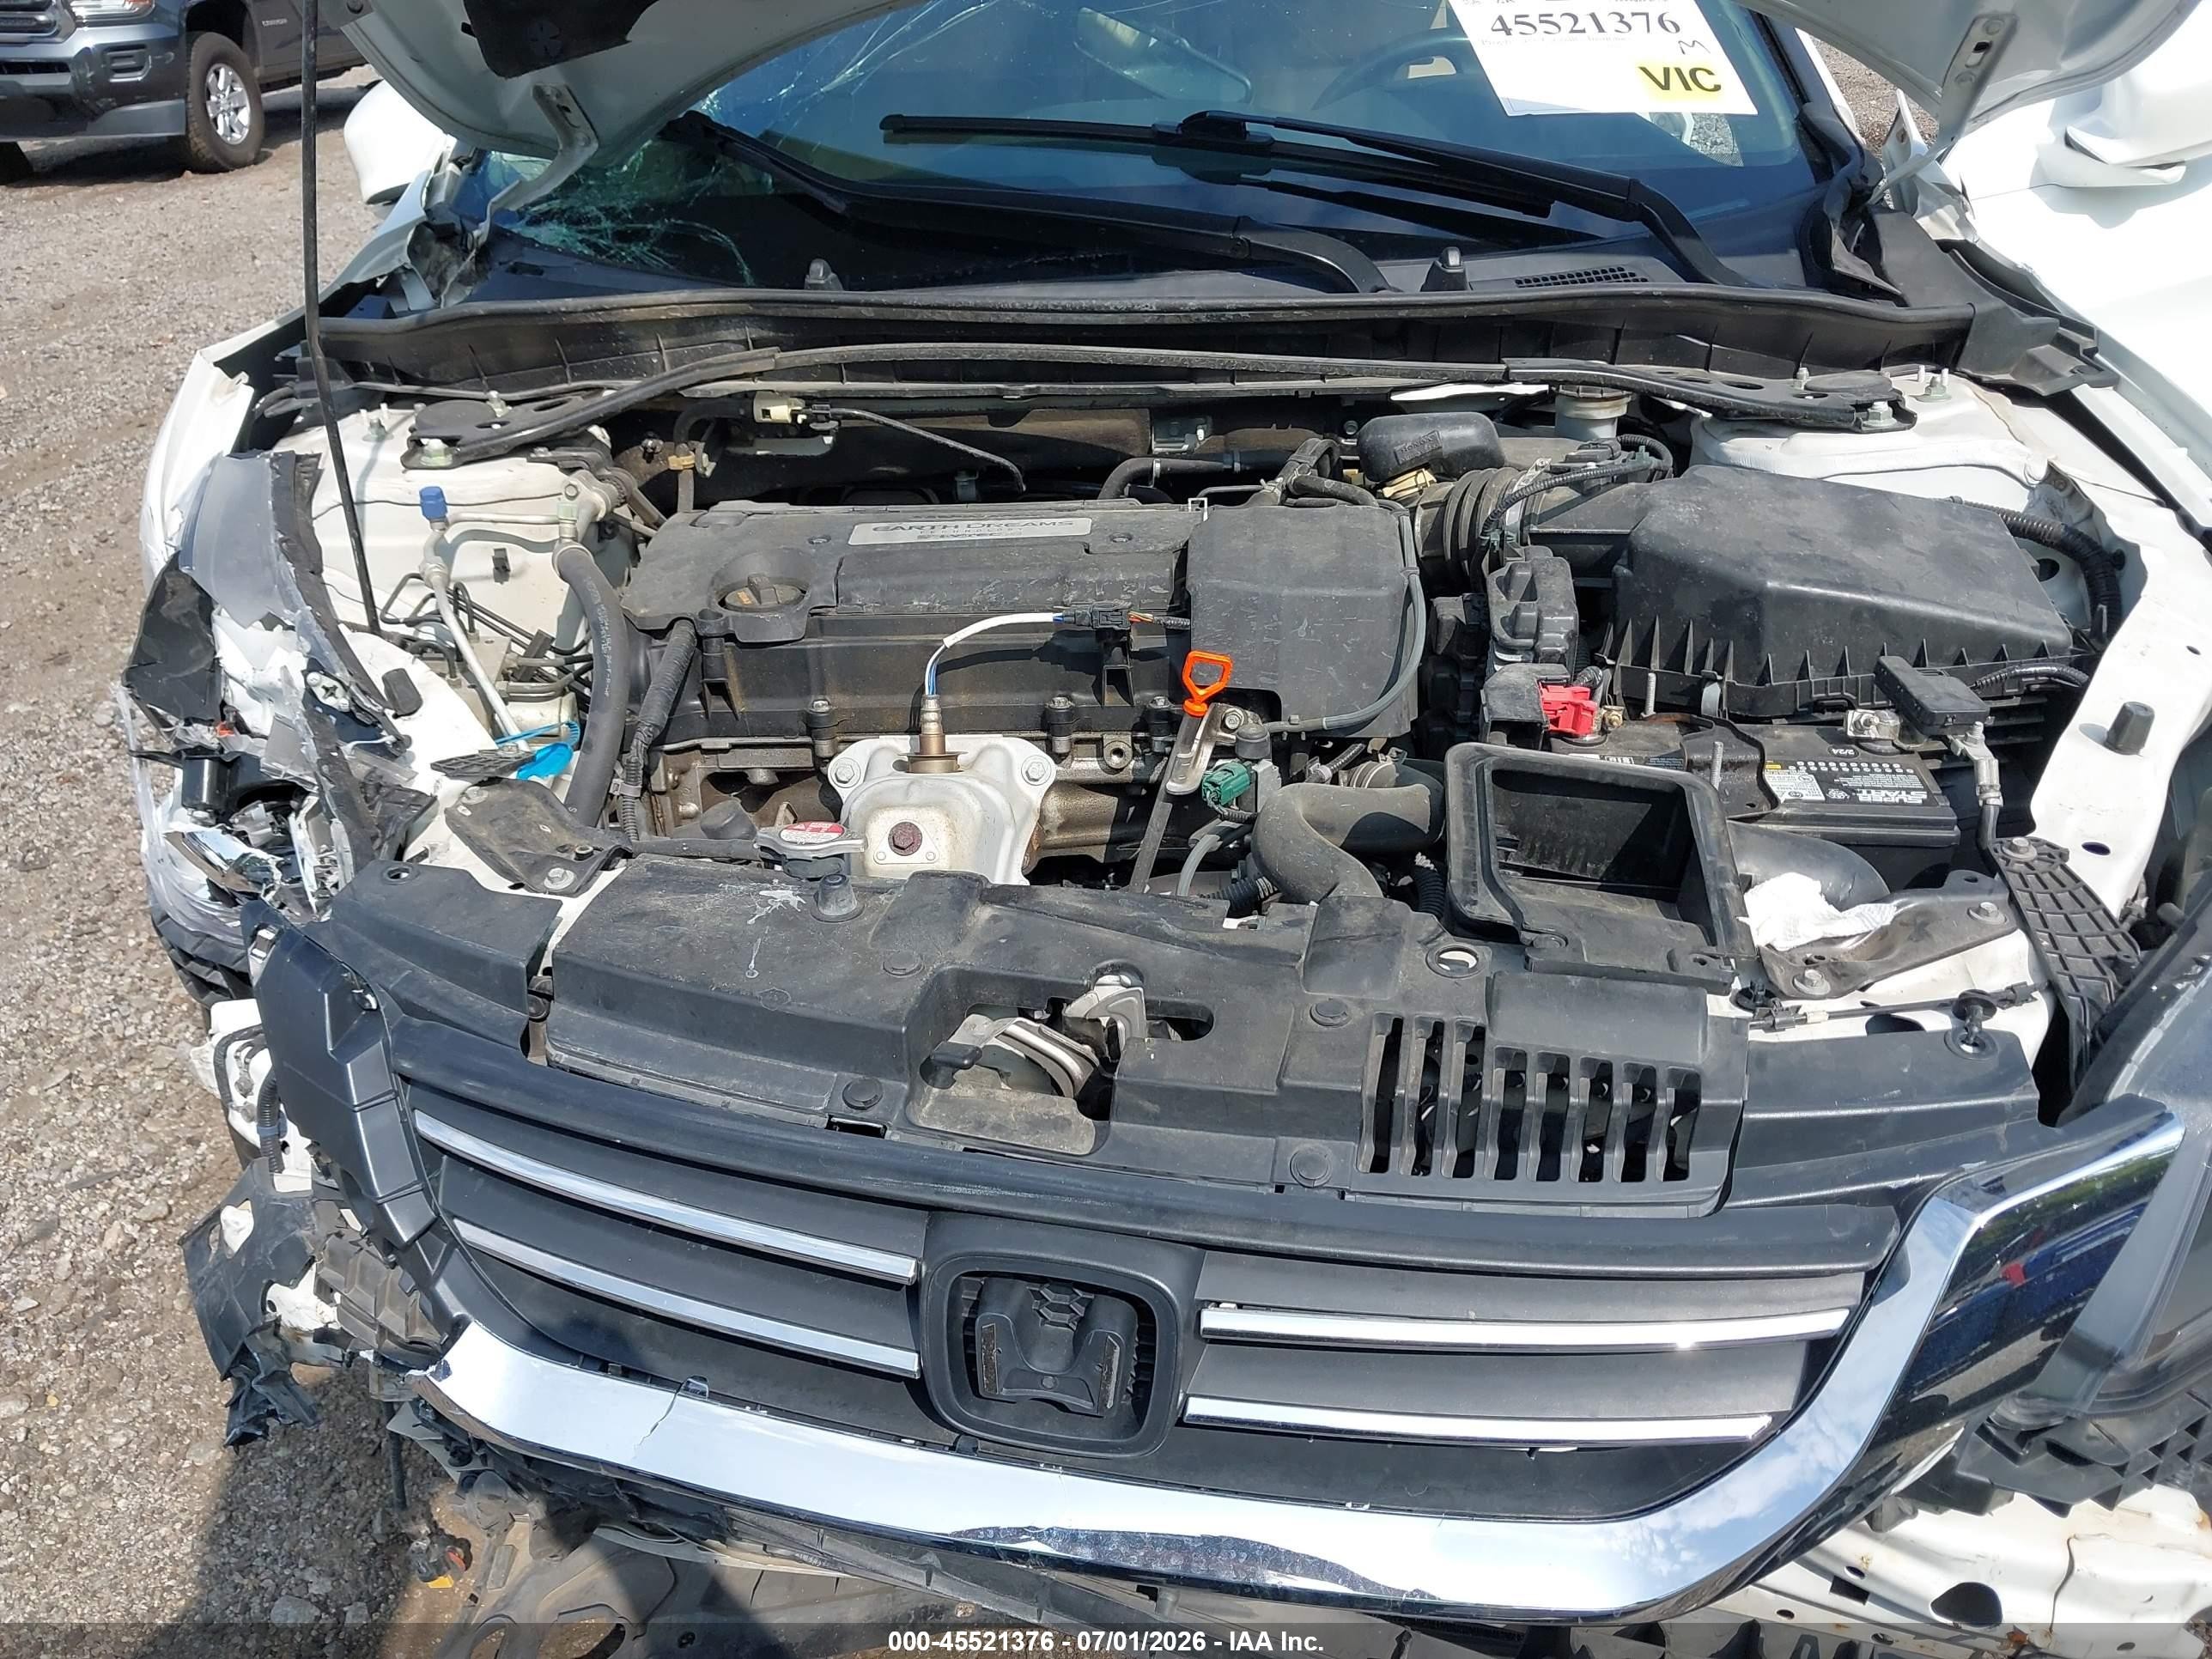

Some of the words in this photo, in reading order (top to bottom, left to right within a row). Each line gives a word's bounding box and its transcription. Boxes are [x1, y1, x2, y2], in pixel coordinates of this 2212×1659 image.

[1491, 11, 1680, 36] 45521376
[1639, 67, 1722, 93] VIC
[872, 524, 959, 532] EARTH
[967, 520, 1073, 529] DREAMS
[1858, 794, 1923, 804] SUPER
